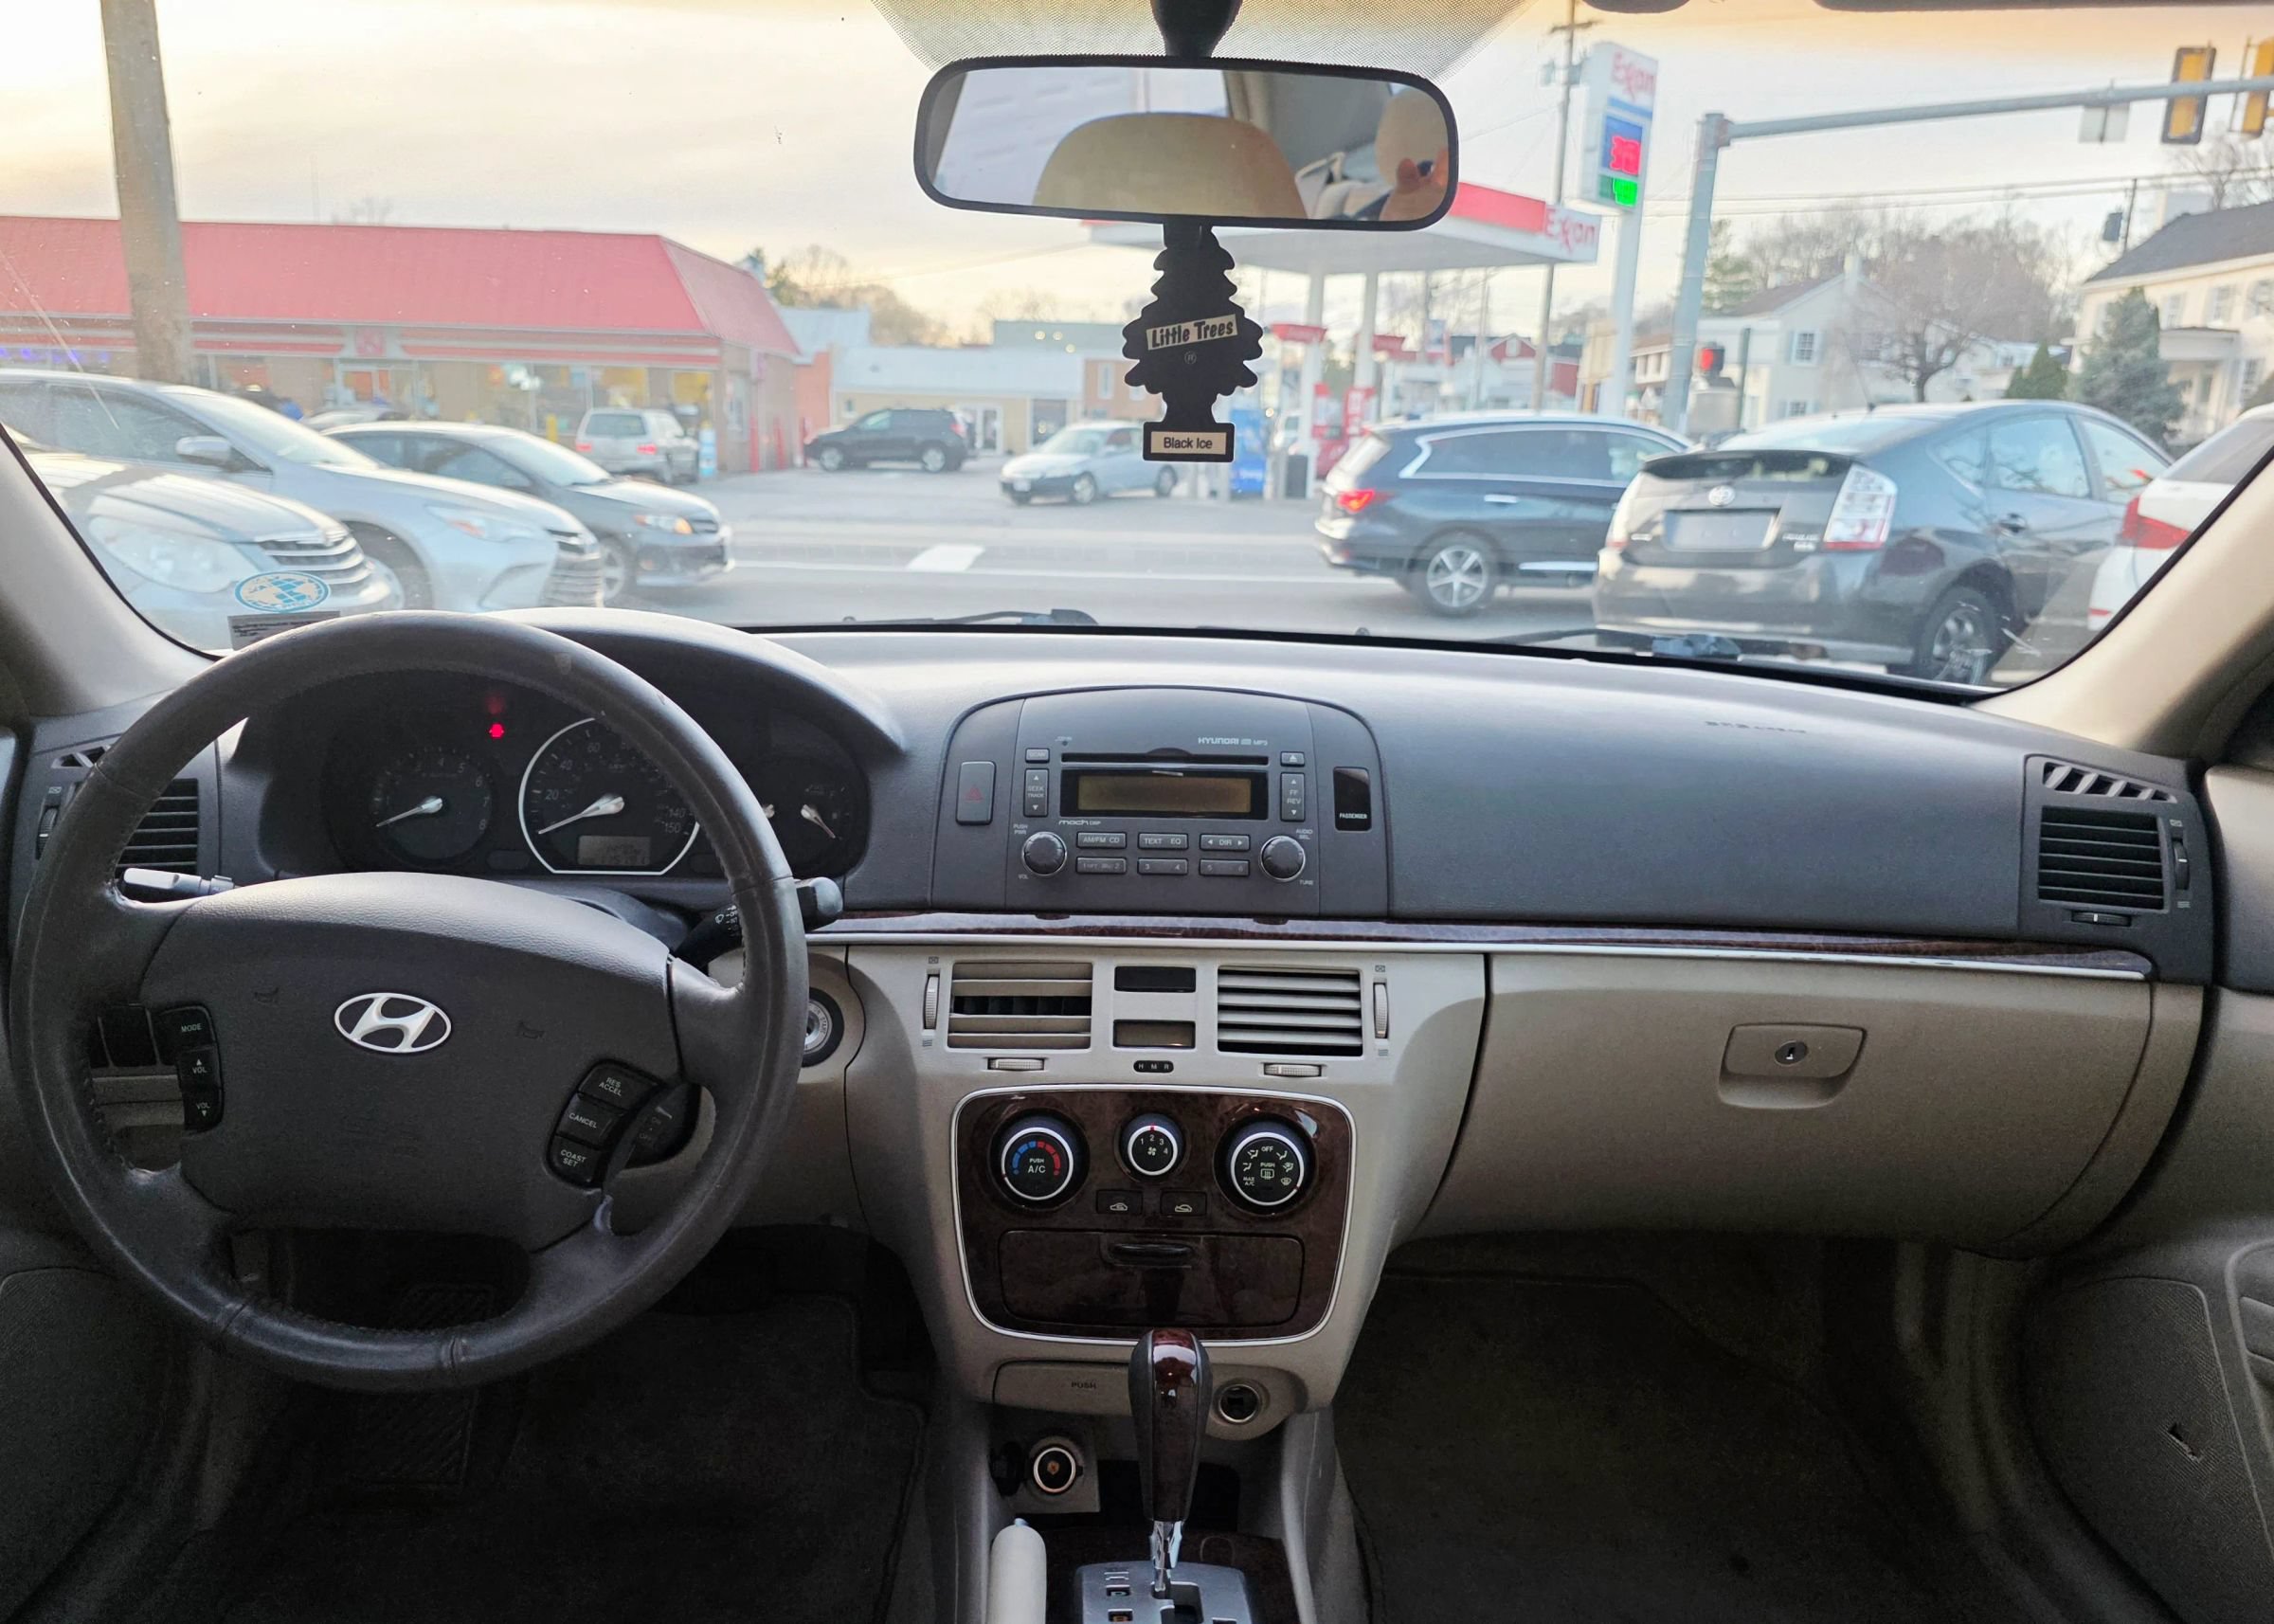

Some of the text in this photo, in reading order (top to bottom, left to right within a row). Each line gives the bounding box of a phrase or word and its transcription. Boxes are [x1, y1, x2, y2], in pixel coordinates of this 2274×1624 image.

[1545, 207, 1596, 253] Exxon
[1151, 319, 1234, 349] Little Trees
[1164, 437, 1213, 449] Black Ice
[1198, 737, 1239, 746] HYUNDAI
[545, 789, 559, 801] 20
[669, 807, 686, 818] 140
[478, 819, 486, 830] 8
[664, 821, 681, 833] 150
[181, 1022, 203, 1033] MODE
[192, 1066, 208, 1074] VOL
[606, 1076, 622, 1088] RES
[598, 1081, 623, 1097] ACCEL
[568, 1111, 598, 1128] CANCEL
[560, 1149, 587, 1163] COAST
[562, 1157, 579, 1167] SET
[1027, 1165, 1046, 1174] A/C
[1071, 1381, 1097, 1390] PUSH
